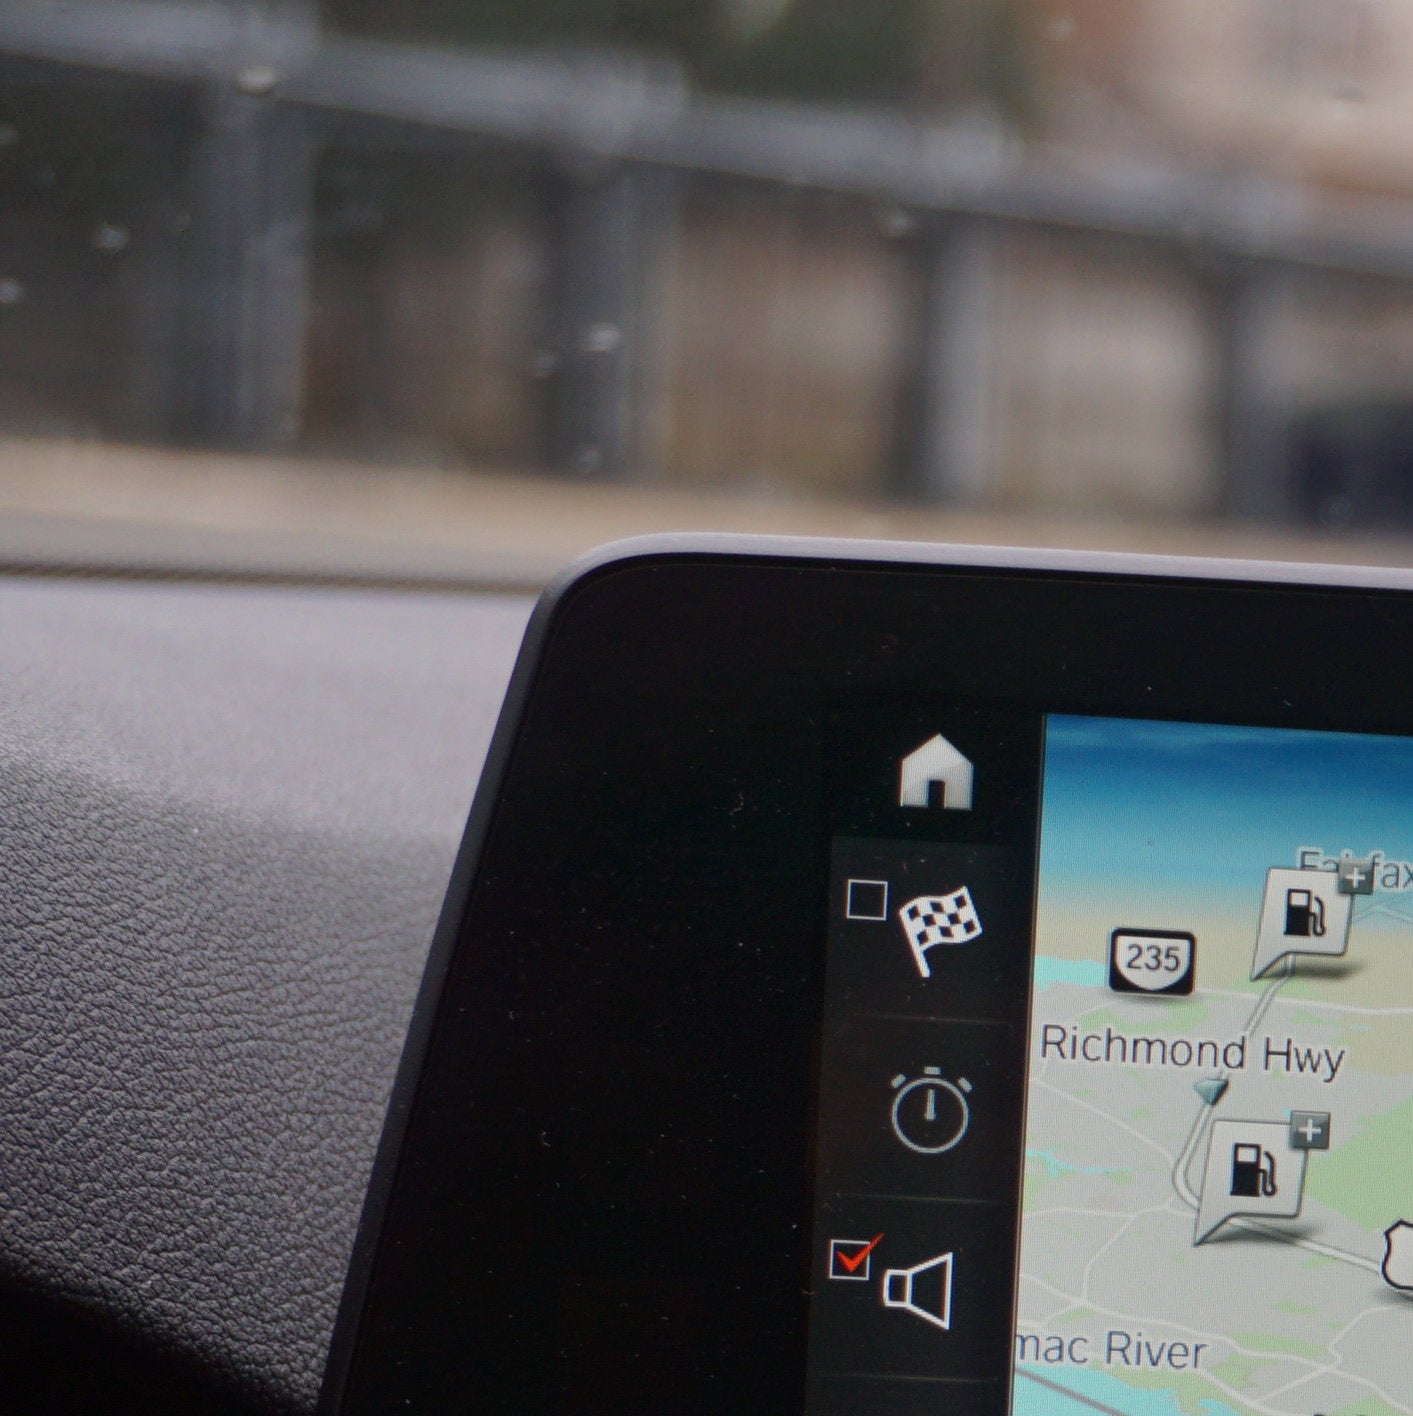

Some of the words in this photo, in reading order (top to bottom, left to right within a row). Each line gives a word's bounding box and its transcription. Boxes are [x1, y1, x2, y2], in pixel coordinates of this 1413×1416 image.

[1125, 944, 1180, 971] 235
[1041, 1025, 1246, 1070] Richmond
[1265, 1037, 1345, 1082] Hwy
[1016, 1333, 1089, 1364] mac
[1106, 1330, 1207, 1369] River
